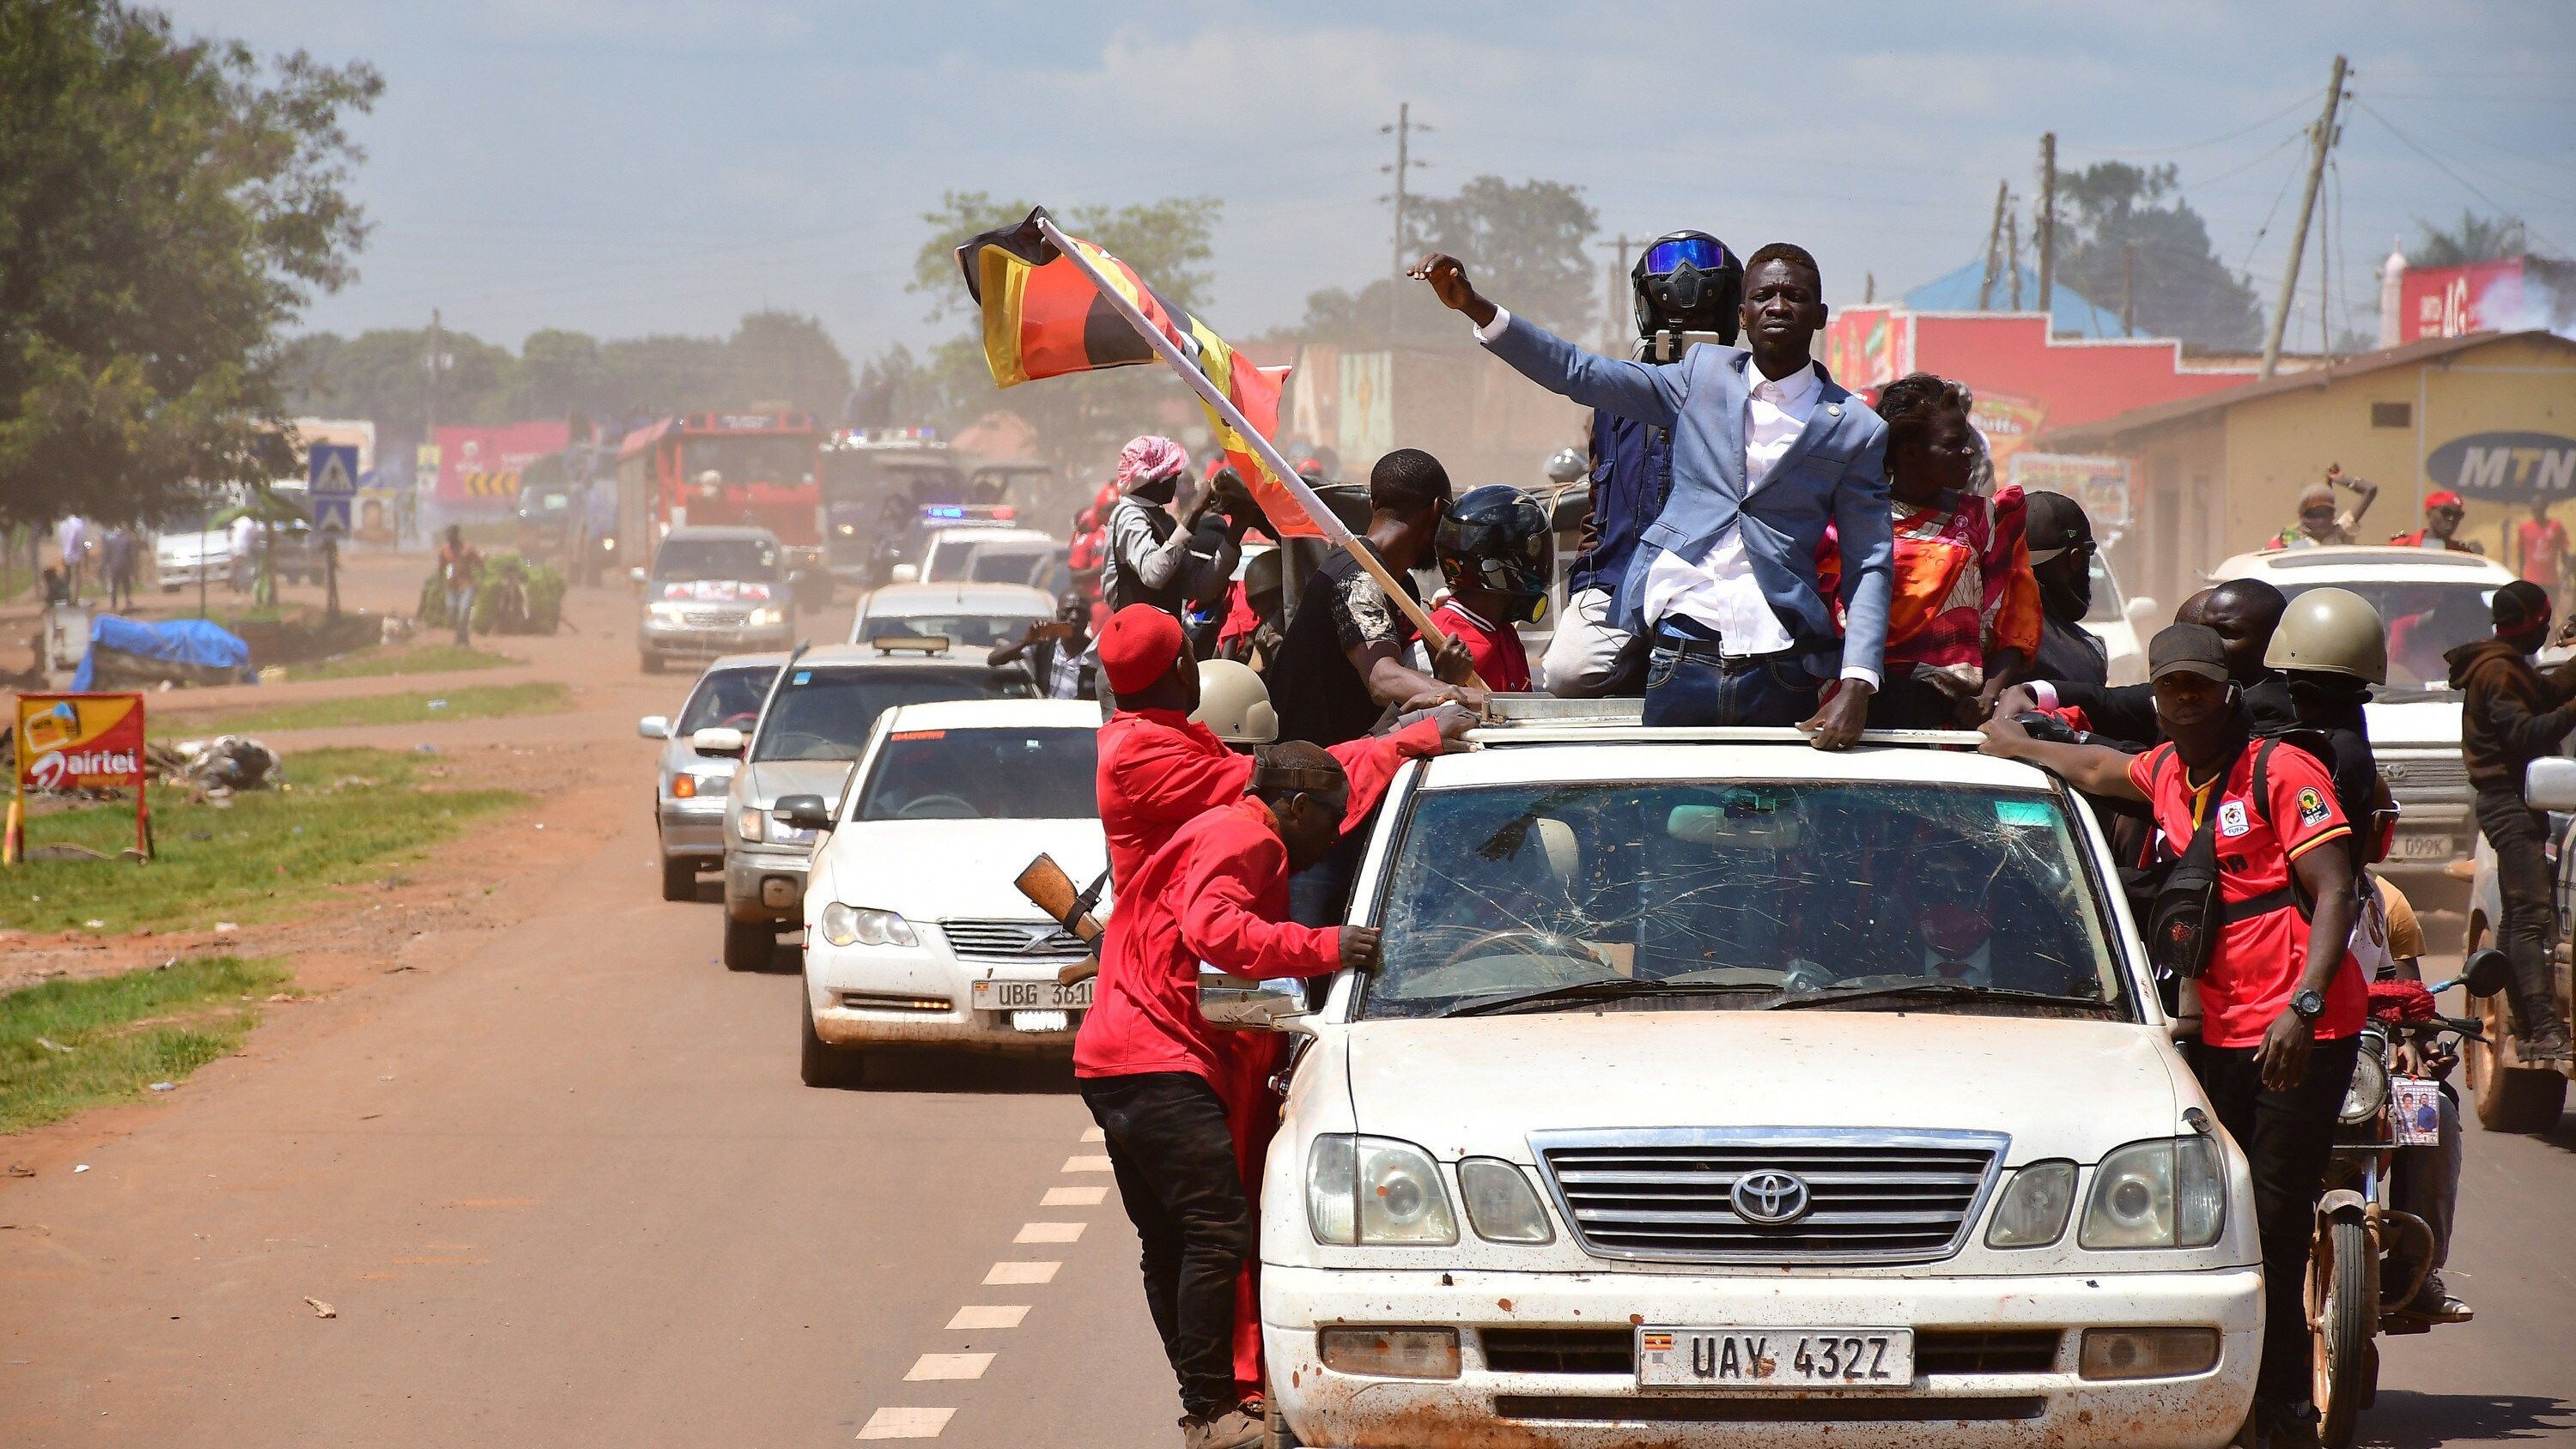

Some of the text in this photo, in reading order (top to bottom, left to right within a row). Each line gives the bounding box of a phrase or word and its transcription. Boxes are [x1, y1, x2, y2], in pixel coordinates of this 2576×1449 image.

[2458, 446, 2576, 489] MTN
[67, 748, 137, 774] airtel
[999, 984, 1092, 1005] UBG 361
[1692, 1337, 1891, 1379] UAY 432Z
